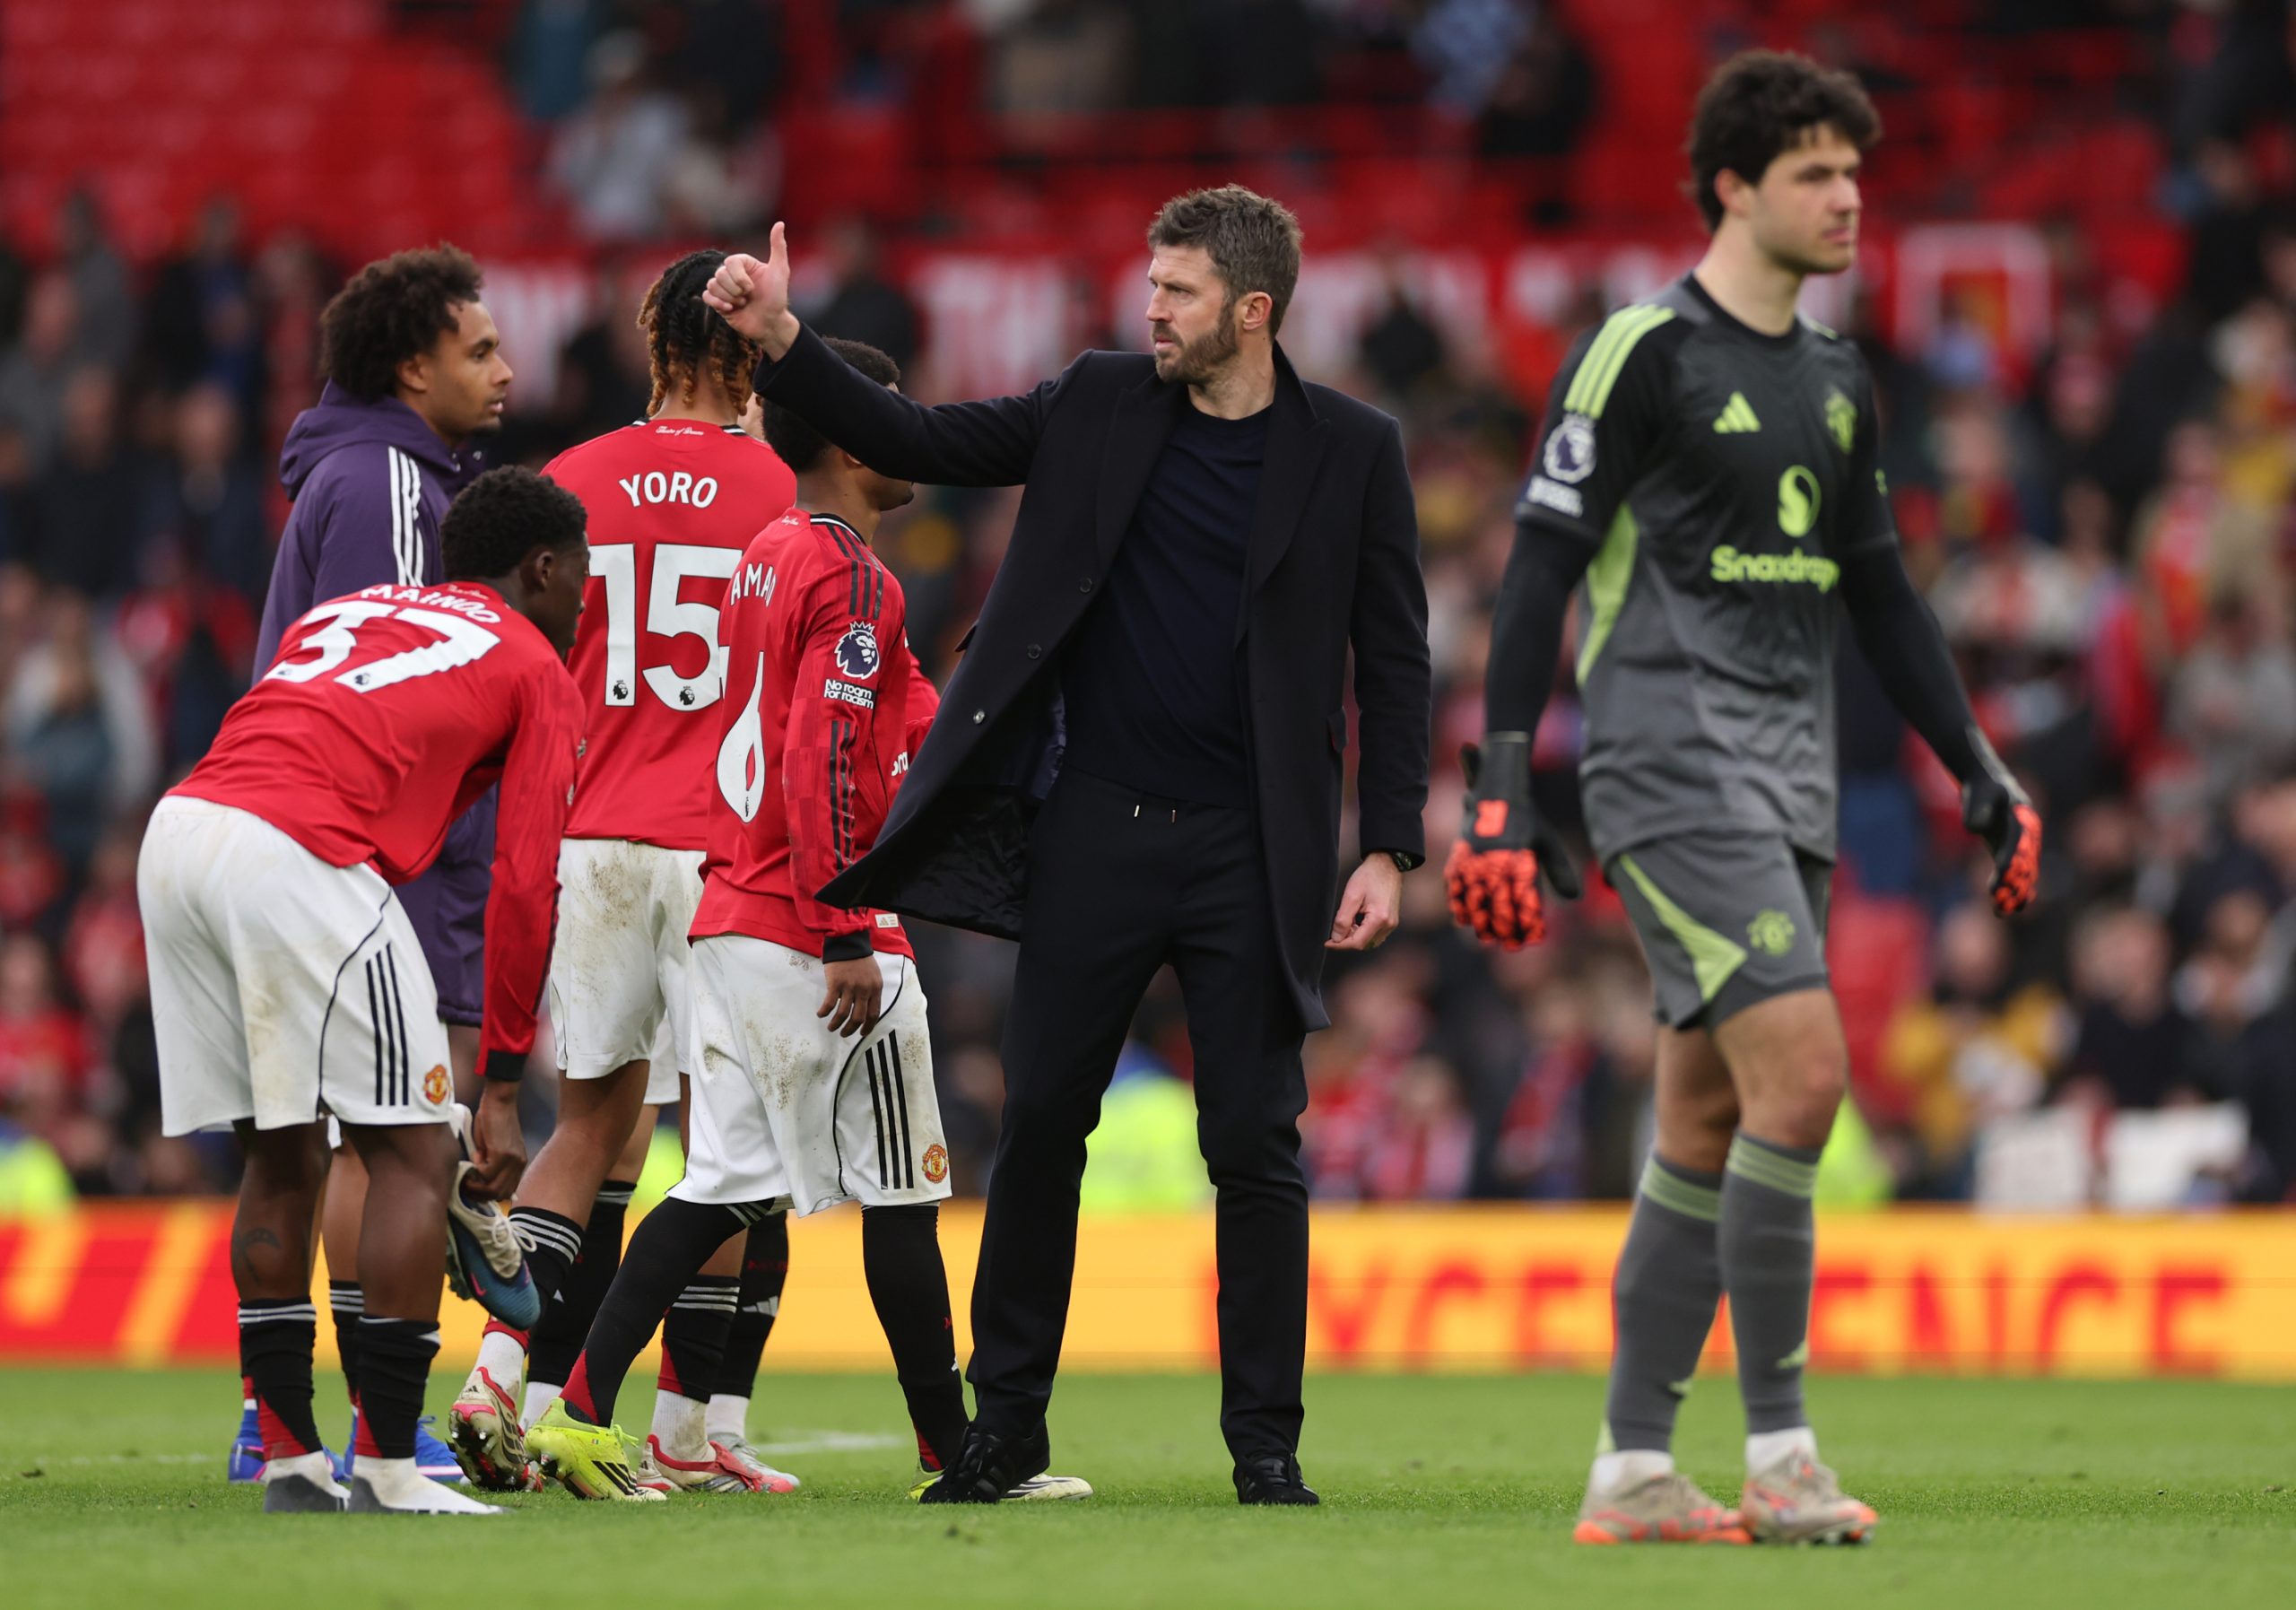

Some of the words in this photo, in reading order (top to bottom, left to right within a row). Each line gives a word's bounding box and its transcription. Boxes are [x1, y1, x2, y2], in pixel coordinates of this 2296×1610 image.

[619, 471, 718, 509] YORO
[361, 585, 501, 622] MAINOO
[587, 543, 743, 711] 15
[262, 600, 501, 693] 37
[825, 678, 843, 691] No
[843, 683, 872, 700] room
[841, 692, 874, 709] racism
